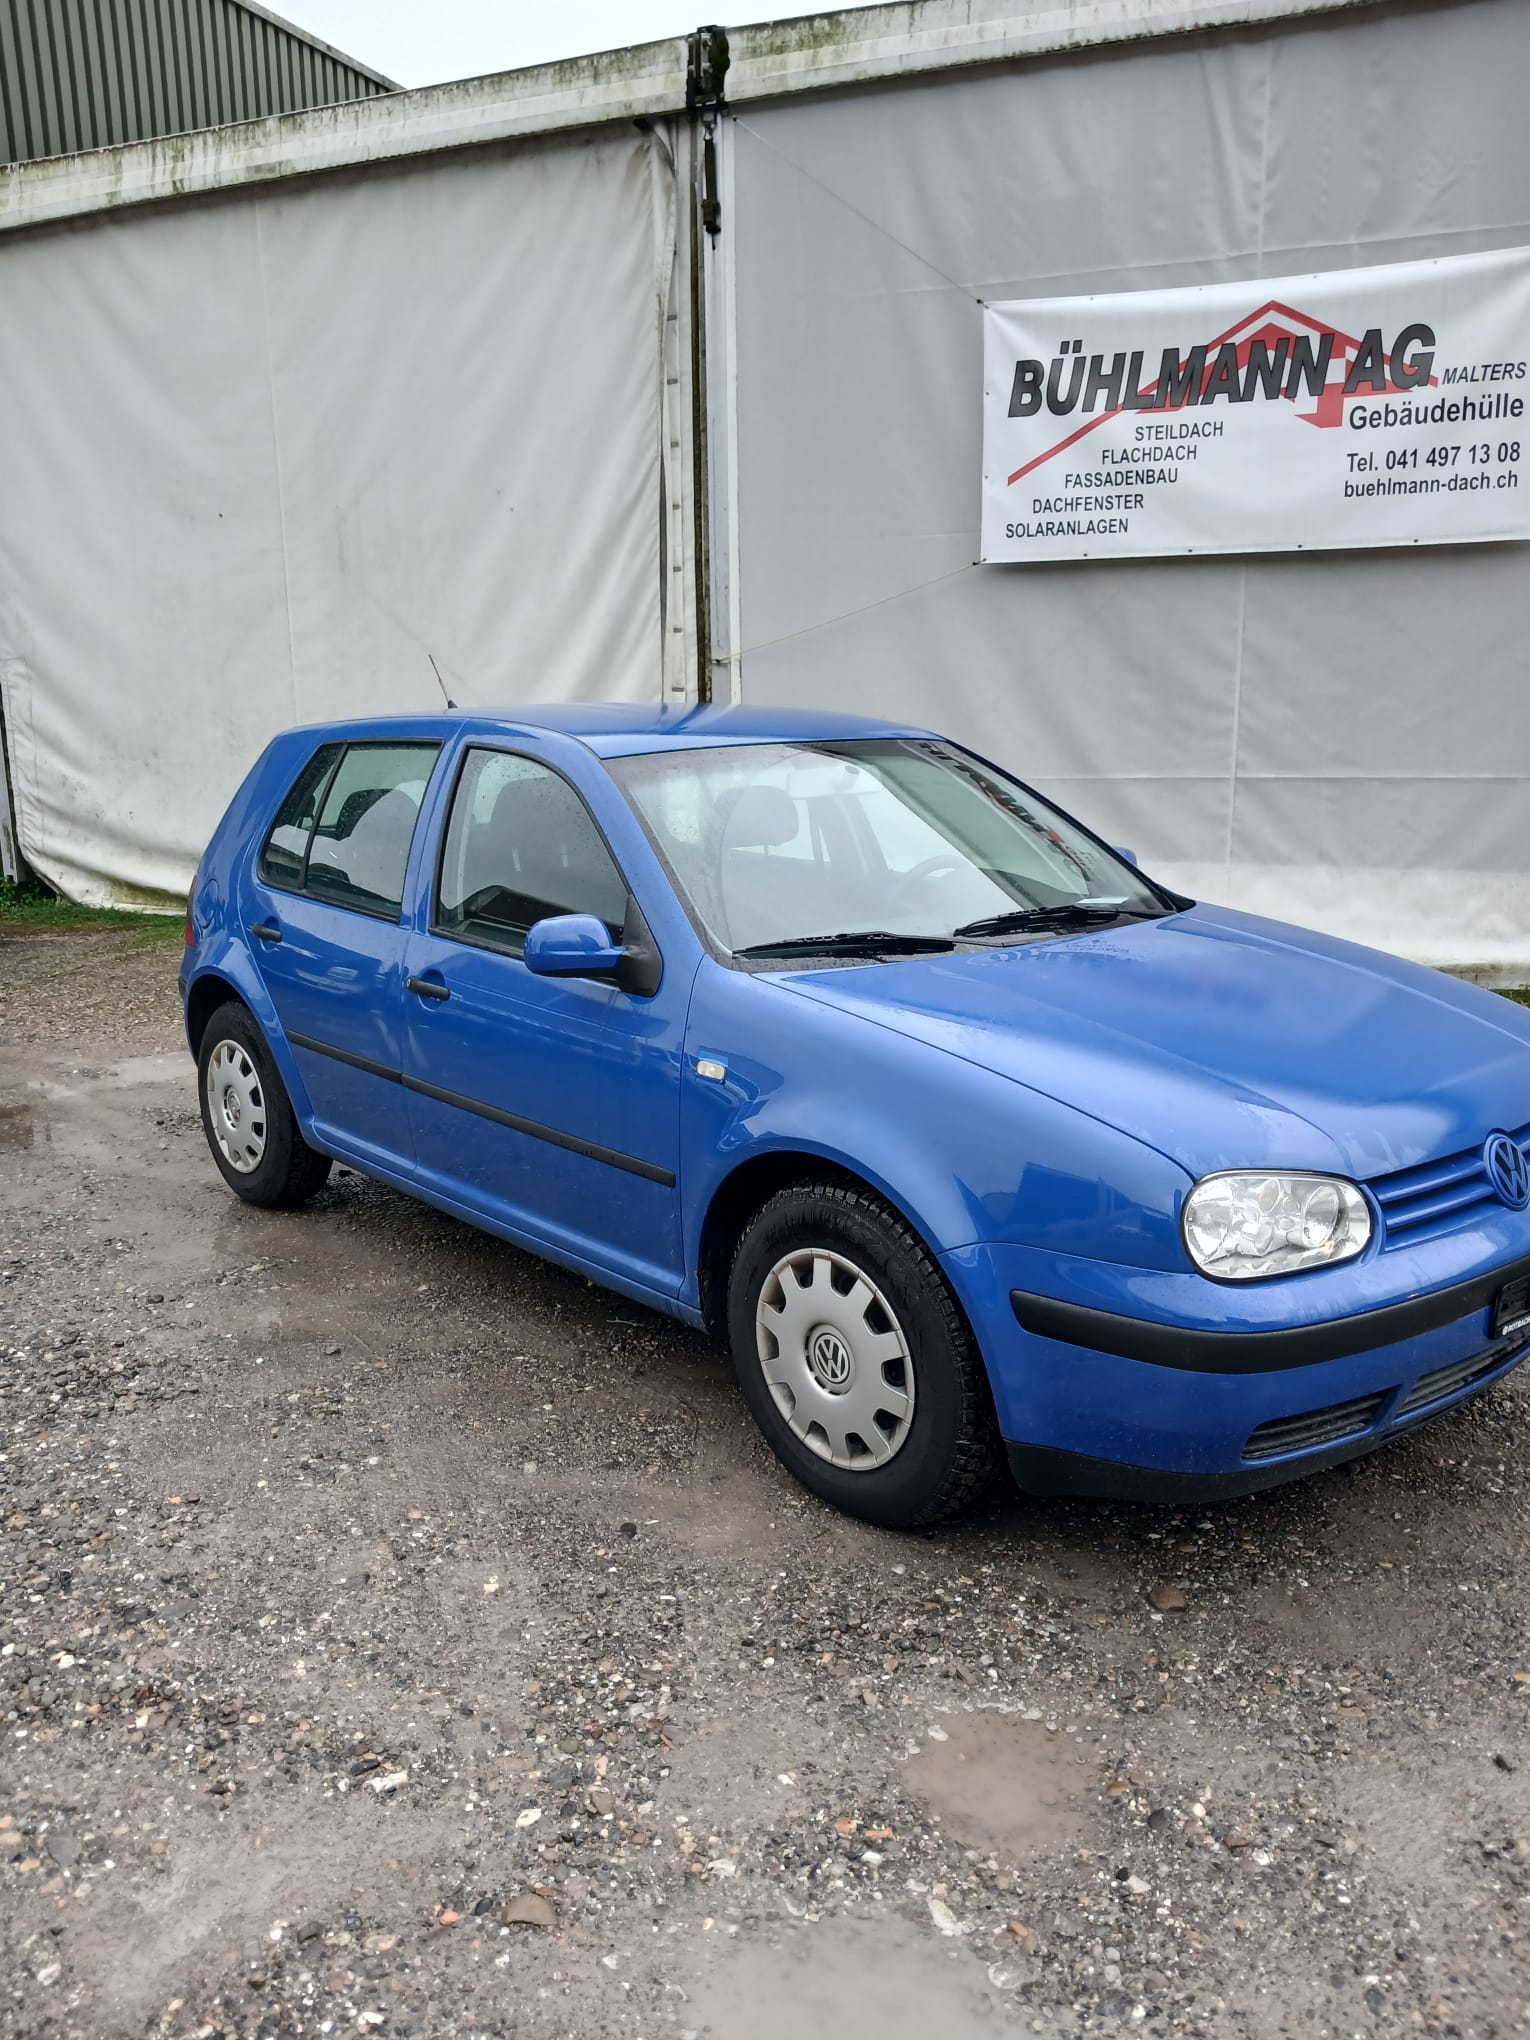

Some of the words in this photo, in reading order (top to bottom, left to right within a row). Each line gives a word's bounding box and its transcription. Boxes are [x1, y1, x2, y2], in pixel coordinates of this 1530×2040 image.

[1007, 333, 1335, 418] BÜHLMANN
[1341, 323, 1436, 394] AG
[1442, 362, 1527, 385] MALTERS
[1349, 392, 1524, 430] Gebäudehülle
[1135, 421, 1224, 442] STEILDACH
[1101, 445, 1197, 465] FLACHDACH
[1346, 452, 1379, 472] Tel.
[1385, 449, 1418, 471] 041
[1425, 446, 1461, 468] 497
[1468, 444, 1491, 464] 13
[1497, 442, 1521, 463] 08
[1064, 468, 1178, 489] FASSADENBAU
[1343, 470, 1518, 498] buehlmann-dach.ch
[1032, 494, 1144, 514] DACHFENSTER
[1005, 518, 1129, 539] SOLARANLAGEN
[814, 1333, 851, 1385] VW
